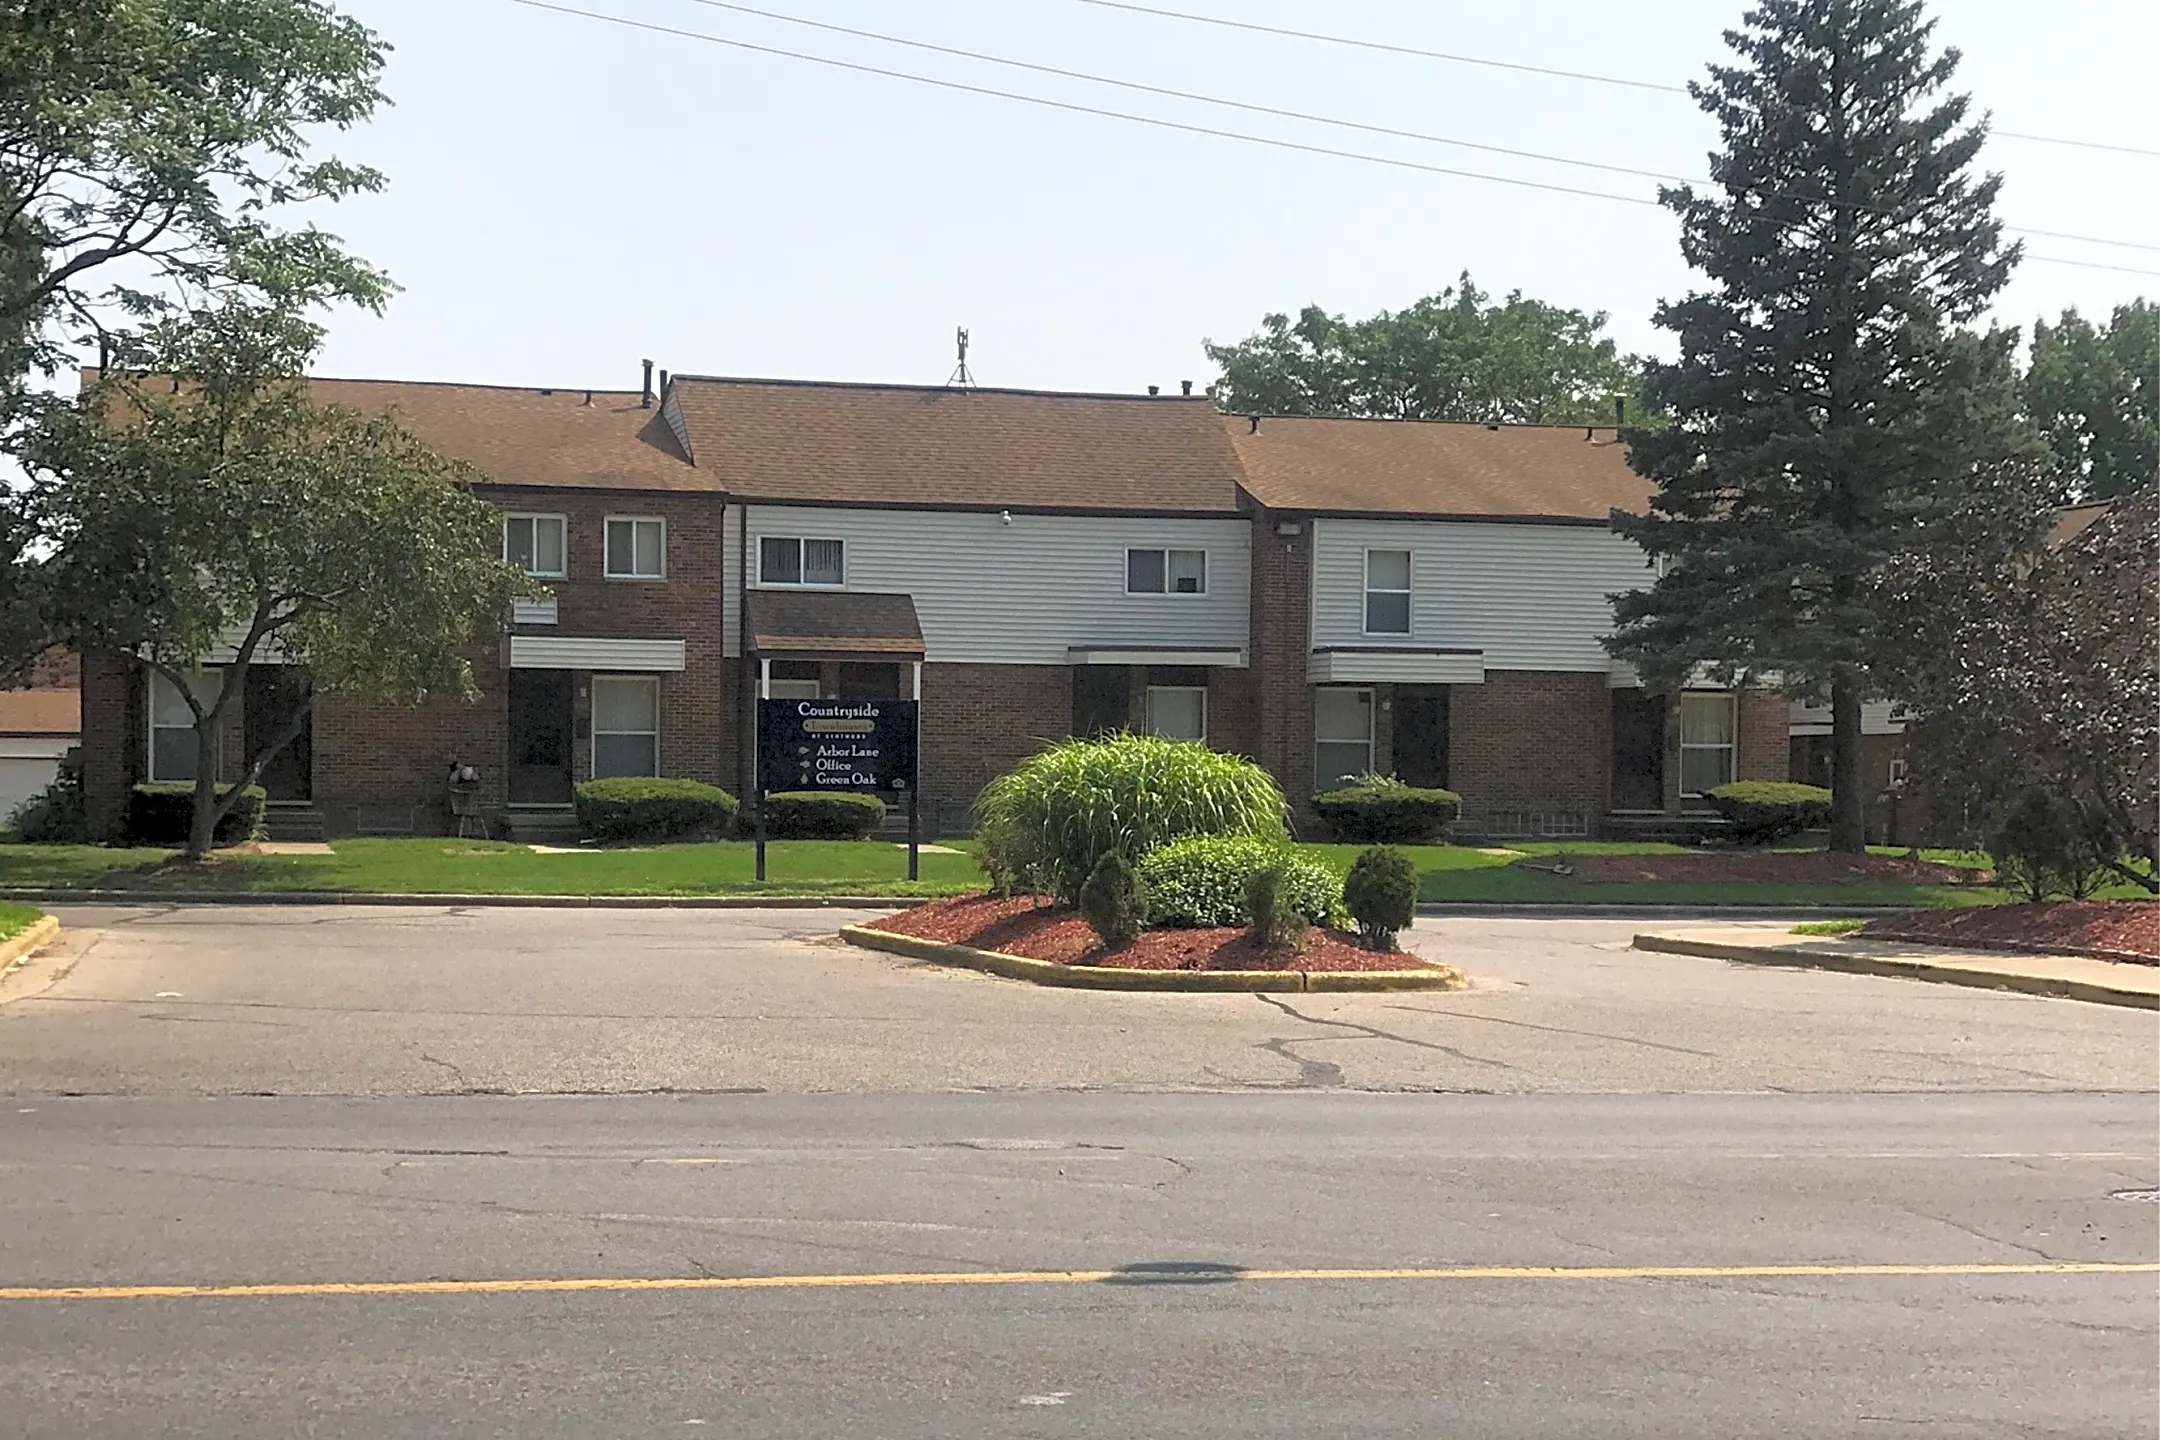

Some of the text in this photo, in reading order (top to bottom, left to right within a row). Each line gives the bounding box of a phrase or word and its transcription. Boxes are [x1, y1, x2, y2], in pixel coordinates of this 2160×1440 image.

[798, 702, 880, 719] Countryside
[816, 744, 880, 757] Arbor Lane
[816, 758, 852, 771] Office
[816, 772, 877, 785] Green Oak
